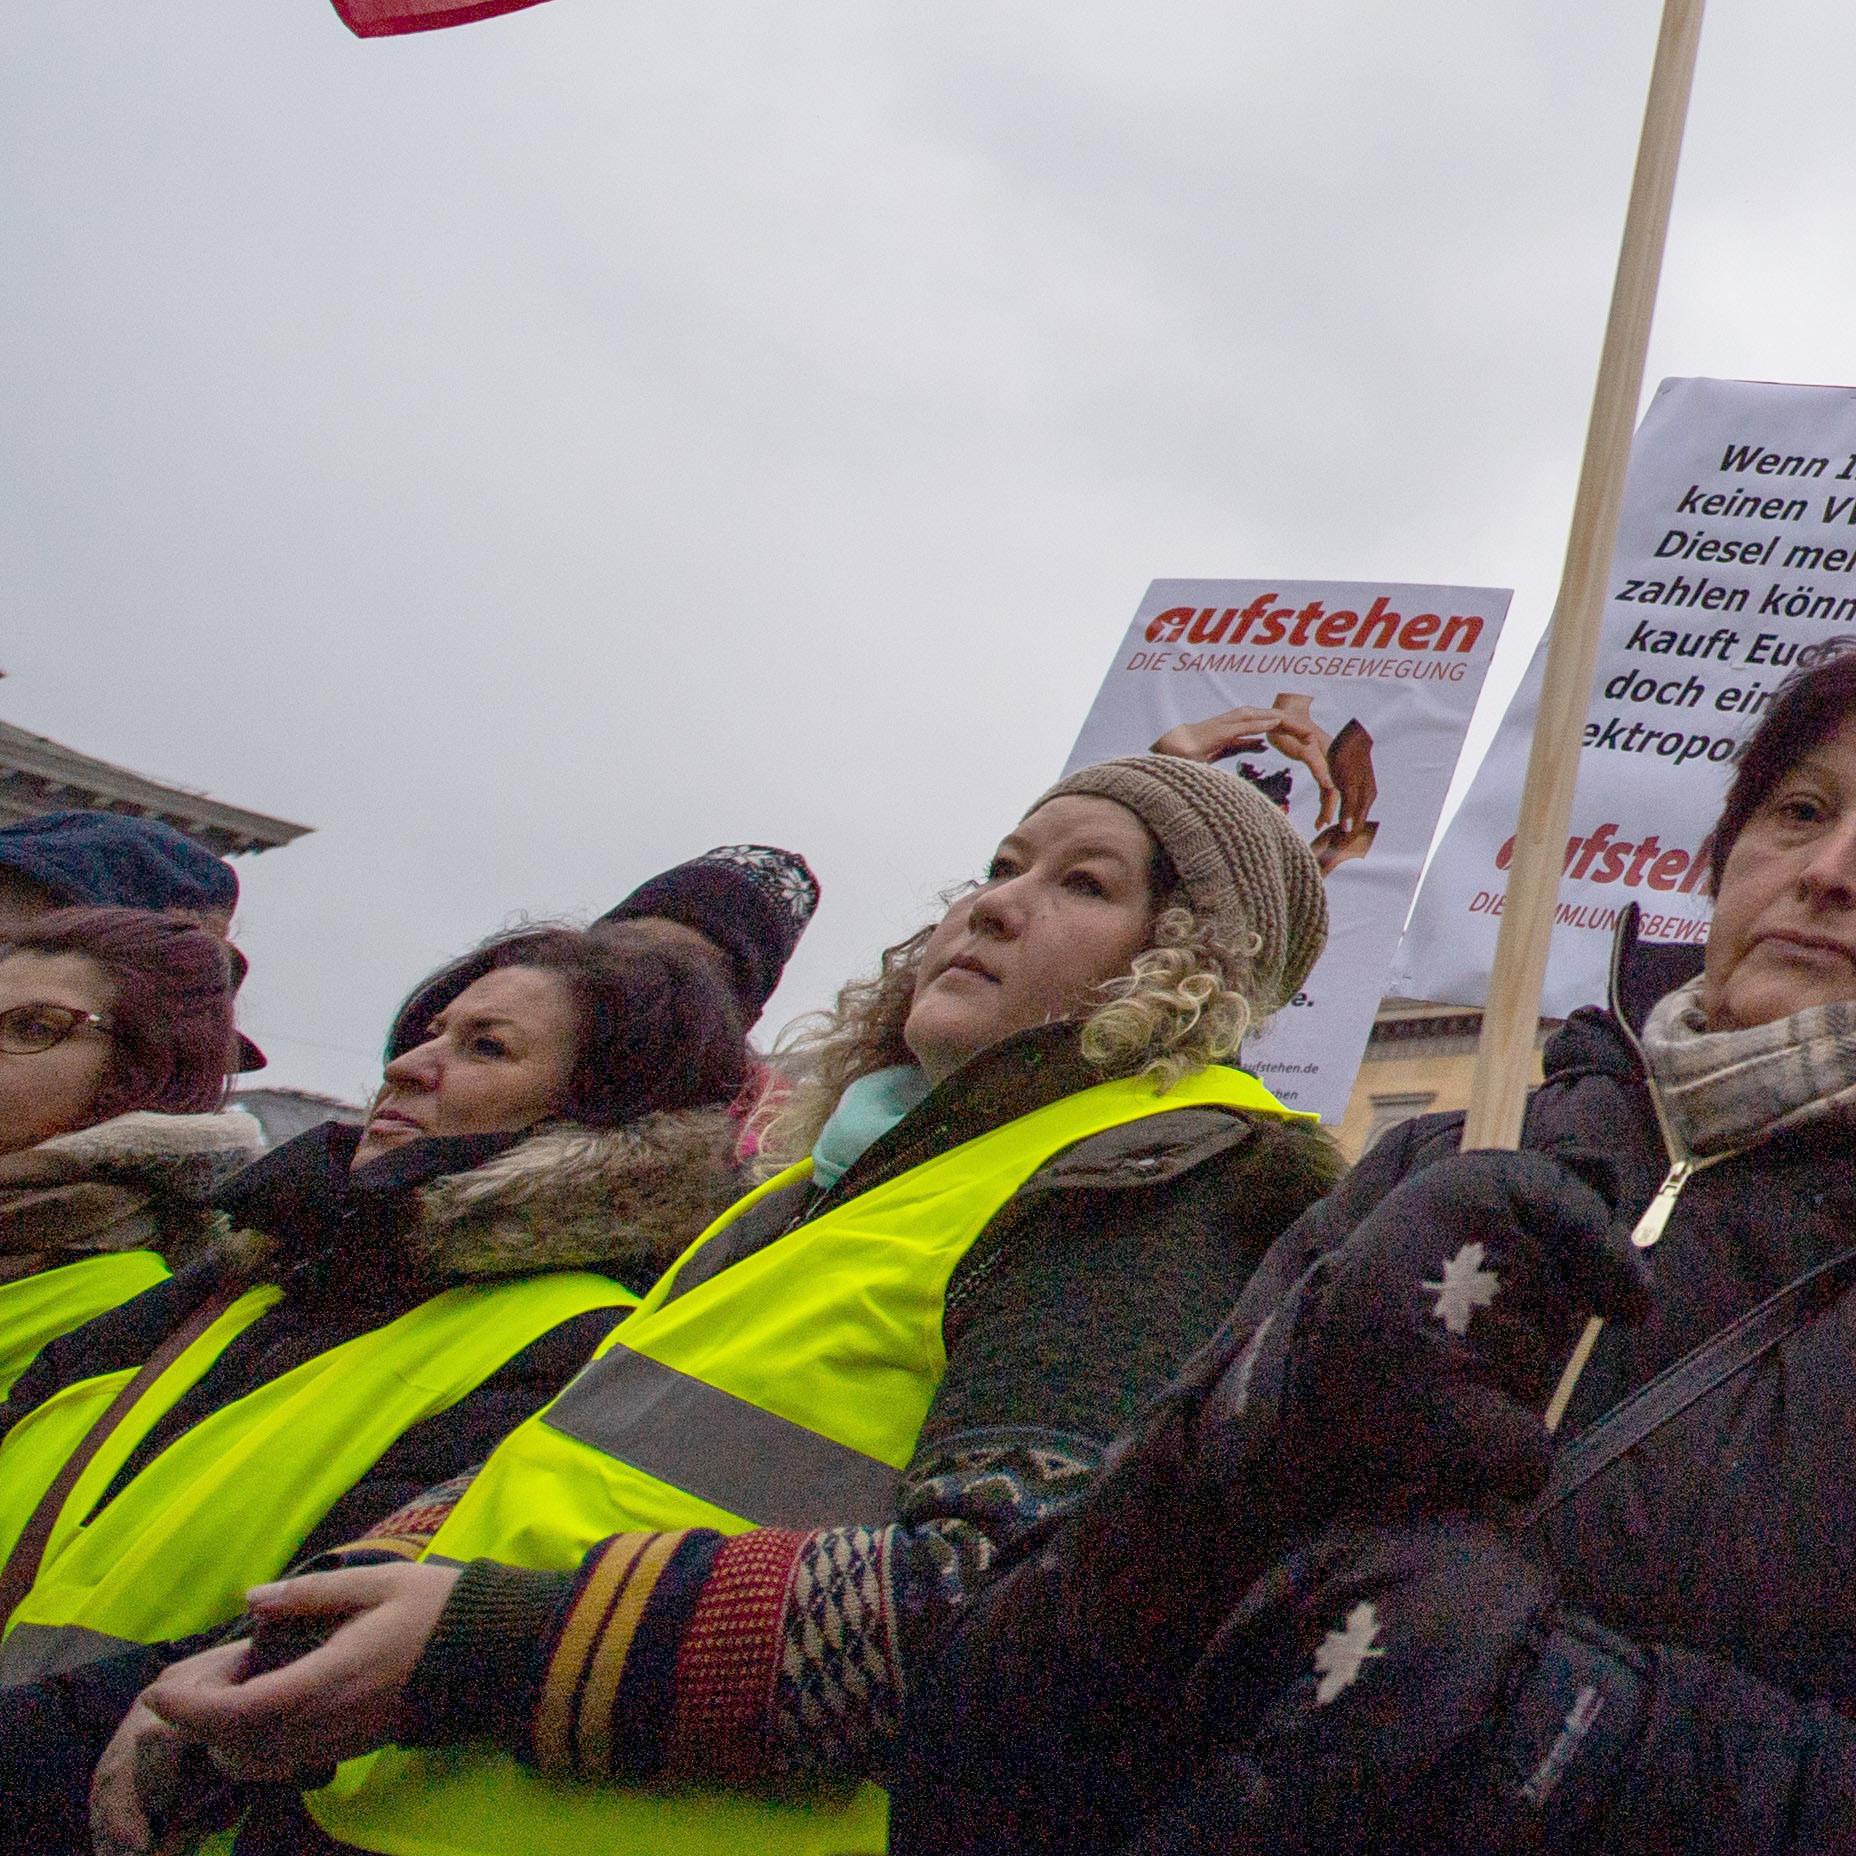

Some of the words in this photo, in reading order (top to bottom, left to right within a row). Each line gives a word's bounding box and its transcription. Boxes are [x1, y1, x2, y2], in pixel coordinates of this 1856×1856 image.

[1720, 445, 1829, 477] Wenn
[1676, 485, 1808, 521] keinen
[1654, 530, 1781, 565] Diesel
[1615, 576, 1750, 611] zahlen
[1145, 593, 1484, 652] aufstehen
[1625, 620, 1740, 660] kauft
[1126, 652, 1172, 671] DIE
[1172, 653, 1467, 682] SAMMLUNGSBEWEGUNG
[1605, 669, 1705, 707] doch
[1468, 891, 1508, 917] DIE
